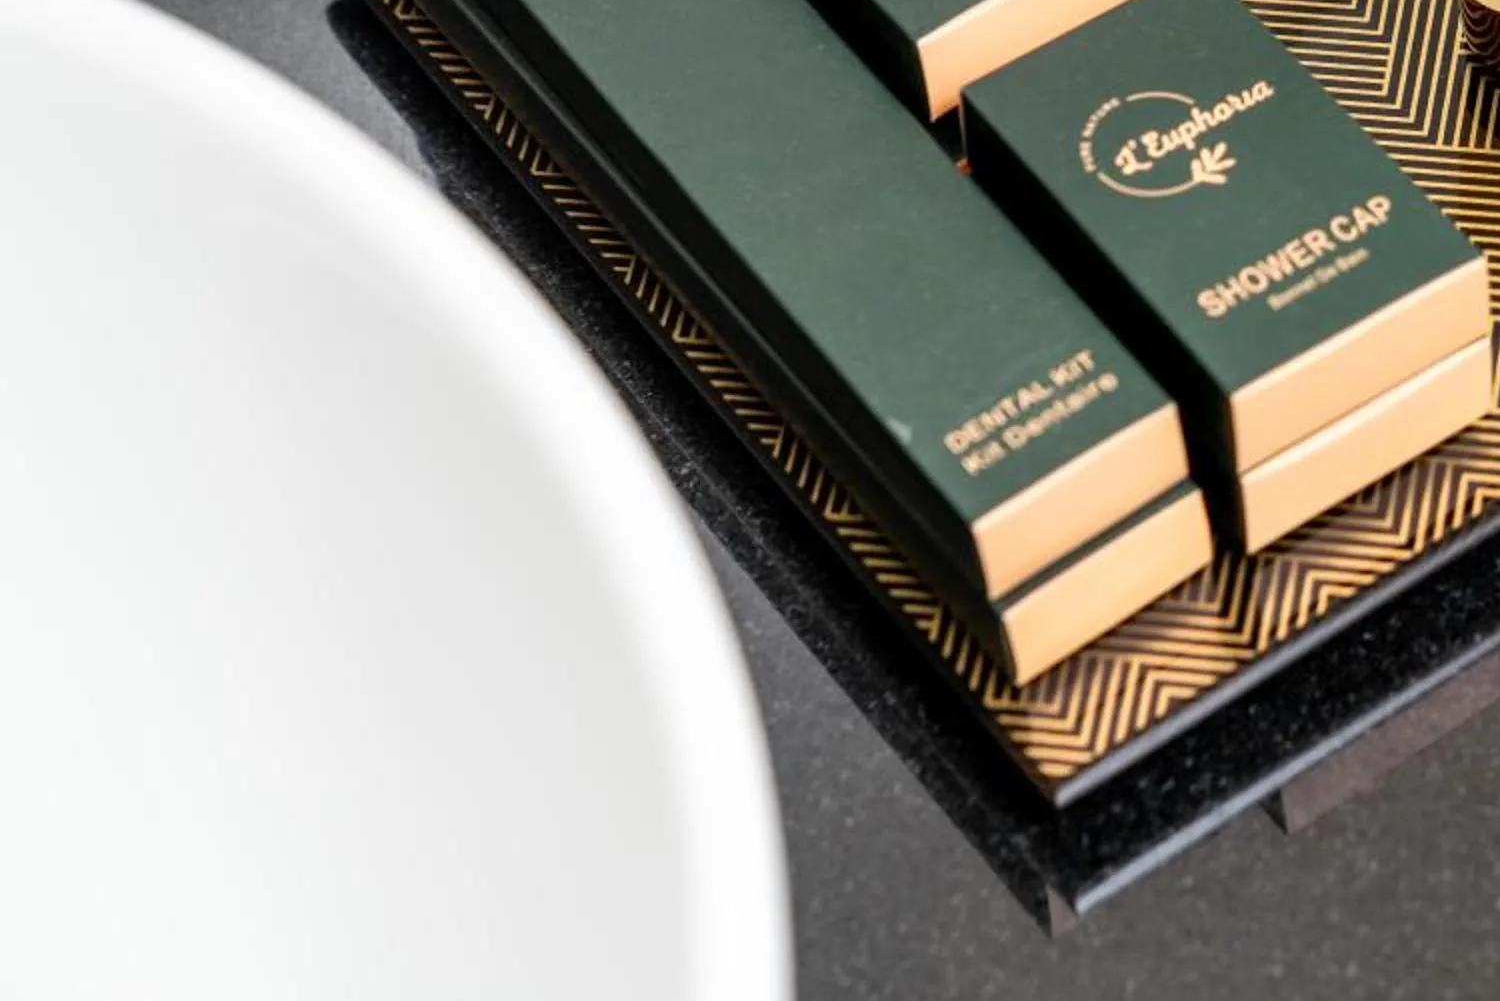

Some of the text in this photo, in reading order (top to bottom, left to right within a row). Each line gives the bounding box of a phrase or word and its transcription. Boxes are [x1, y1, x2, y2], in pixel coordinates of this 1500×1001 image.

[1197, 194, 1392, 318] SHOWER CAP
[943, 349, 1096, 455] DENTAL KIT
